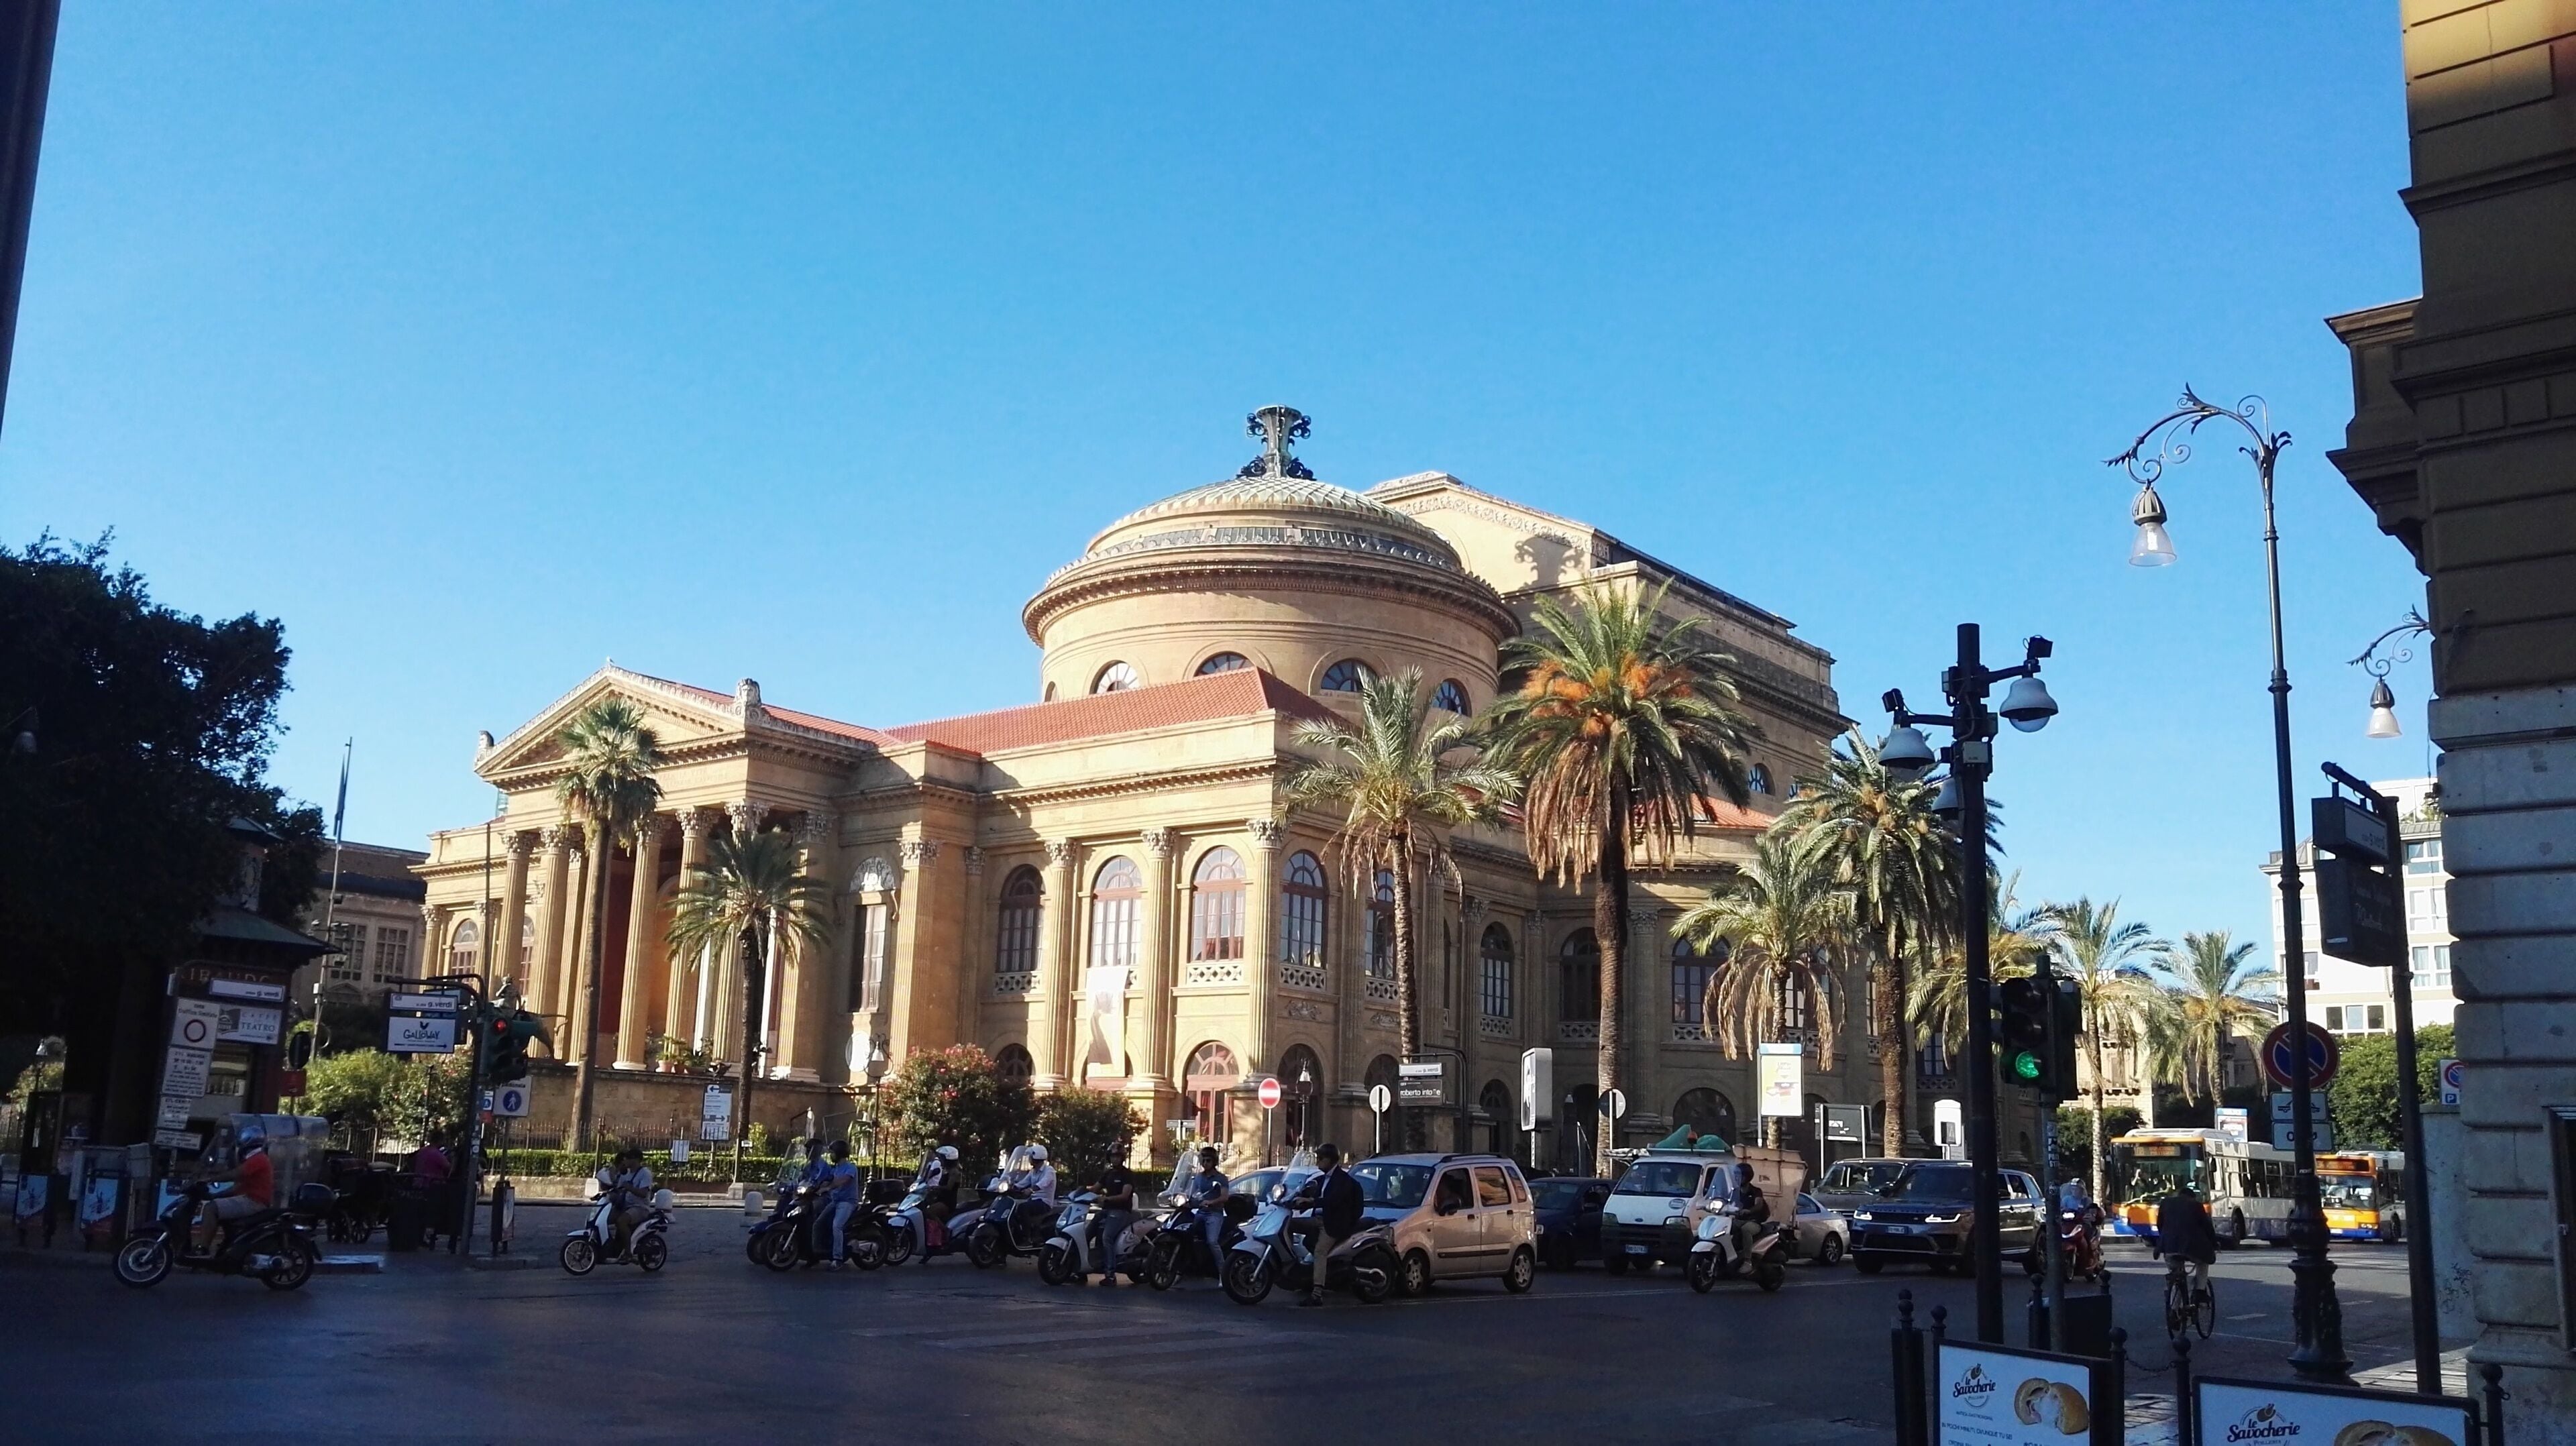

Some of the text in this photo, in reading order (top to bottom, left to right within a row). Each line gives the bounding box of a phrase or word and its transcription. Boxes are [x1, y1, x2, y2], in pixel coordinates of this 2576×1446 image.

[241, 1023, 275, 1032] TEATRO
[1953, 1379, 1996, 1398] Savocherie
[2227, 1422, 2300, 1443] Savocherie
